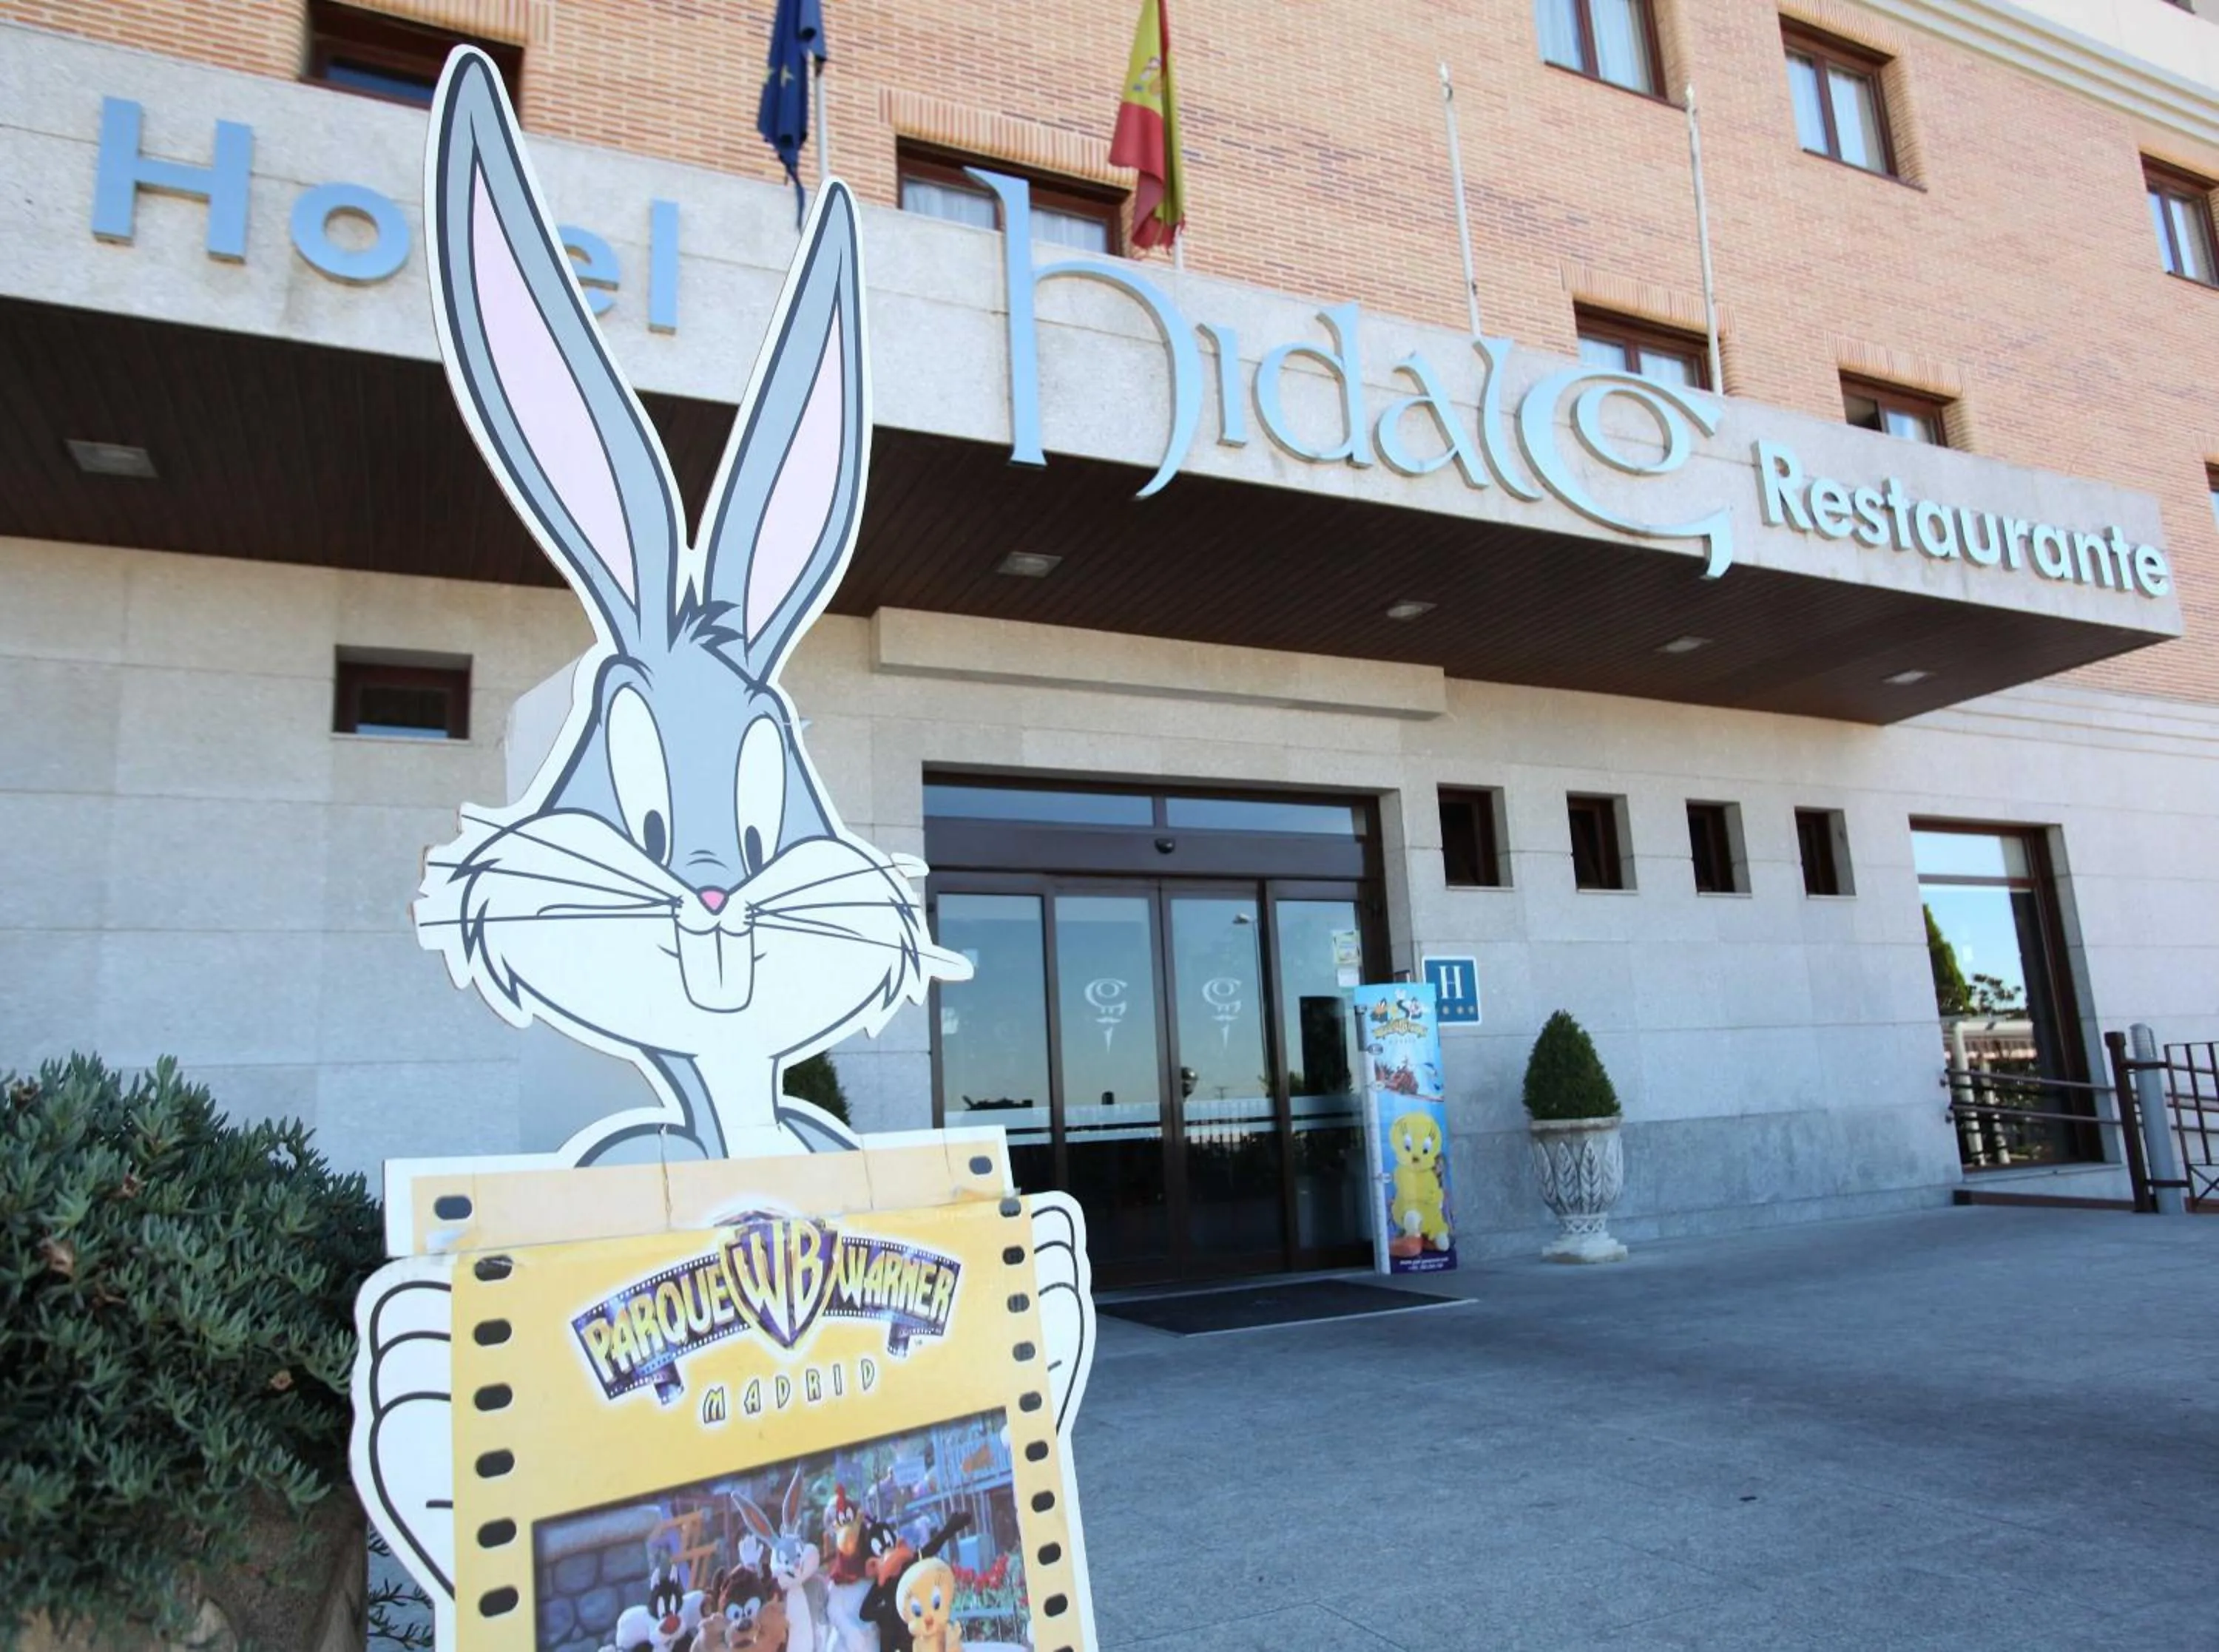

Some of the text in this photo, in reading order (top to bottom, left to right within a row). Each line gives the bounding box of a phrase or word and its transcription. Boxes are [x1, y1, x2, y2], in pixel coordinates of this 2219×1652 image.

[92, 96, 679, 334] Hoel
[1752, 438, 2169, 598] Restaurante
[1439, 965, 1464, 999] H
[584, 1219, 956, 1383] PARQUE WB WARNER
[703, 1358, 875, 1424] MADRID
